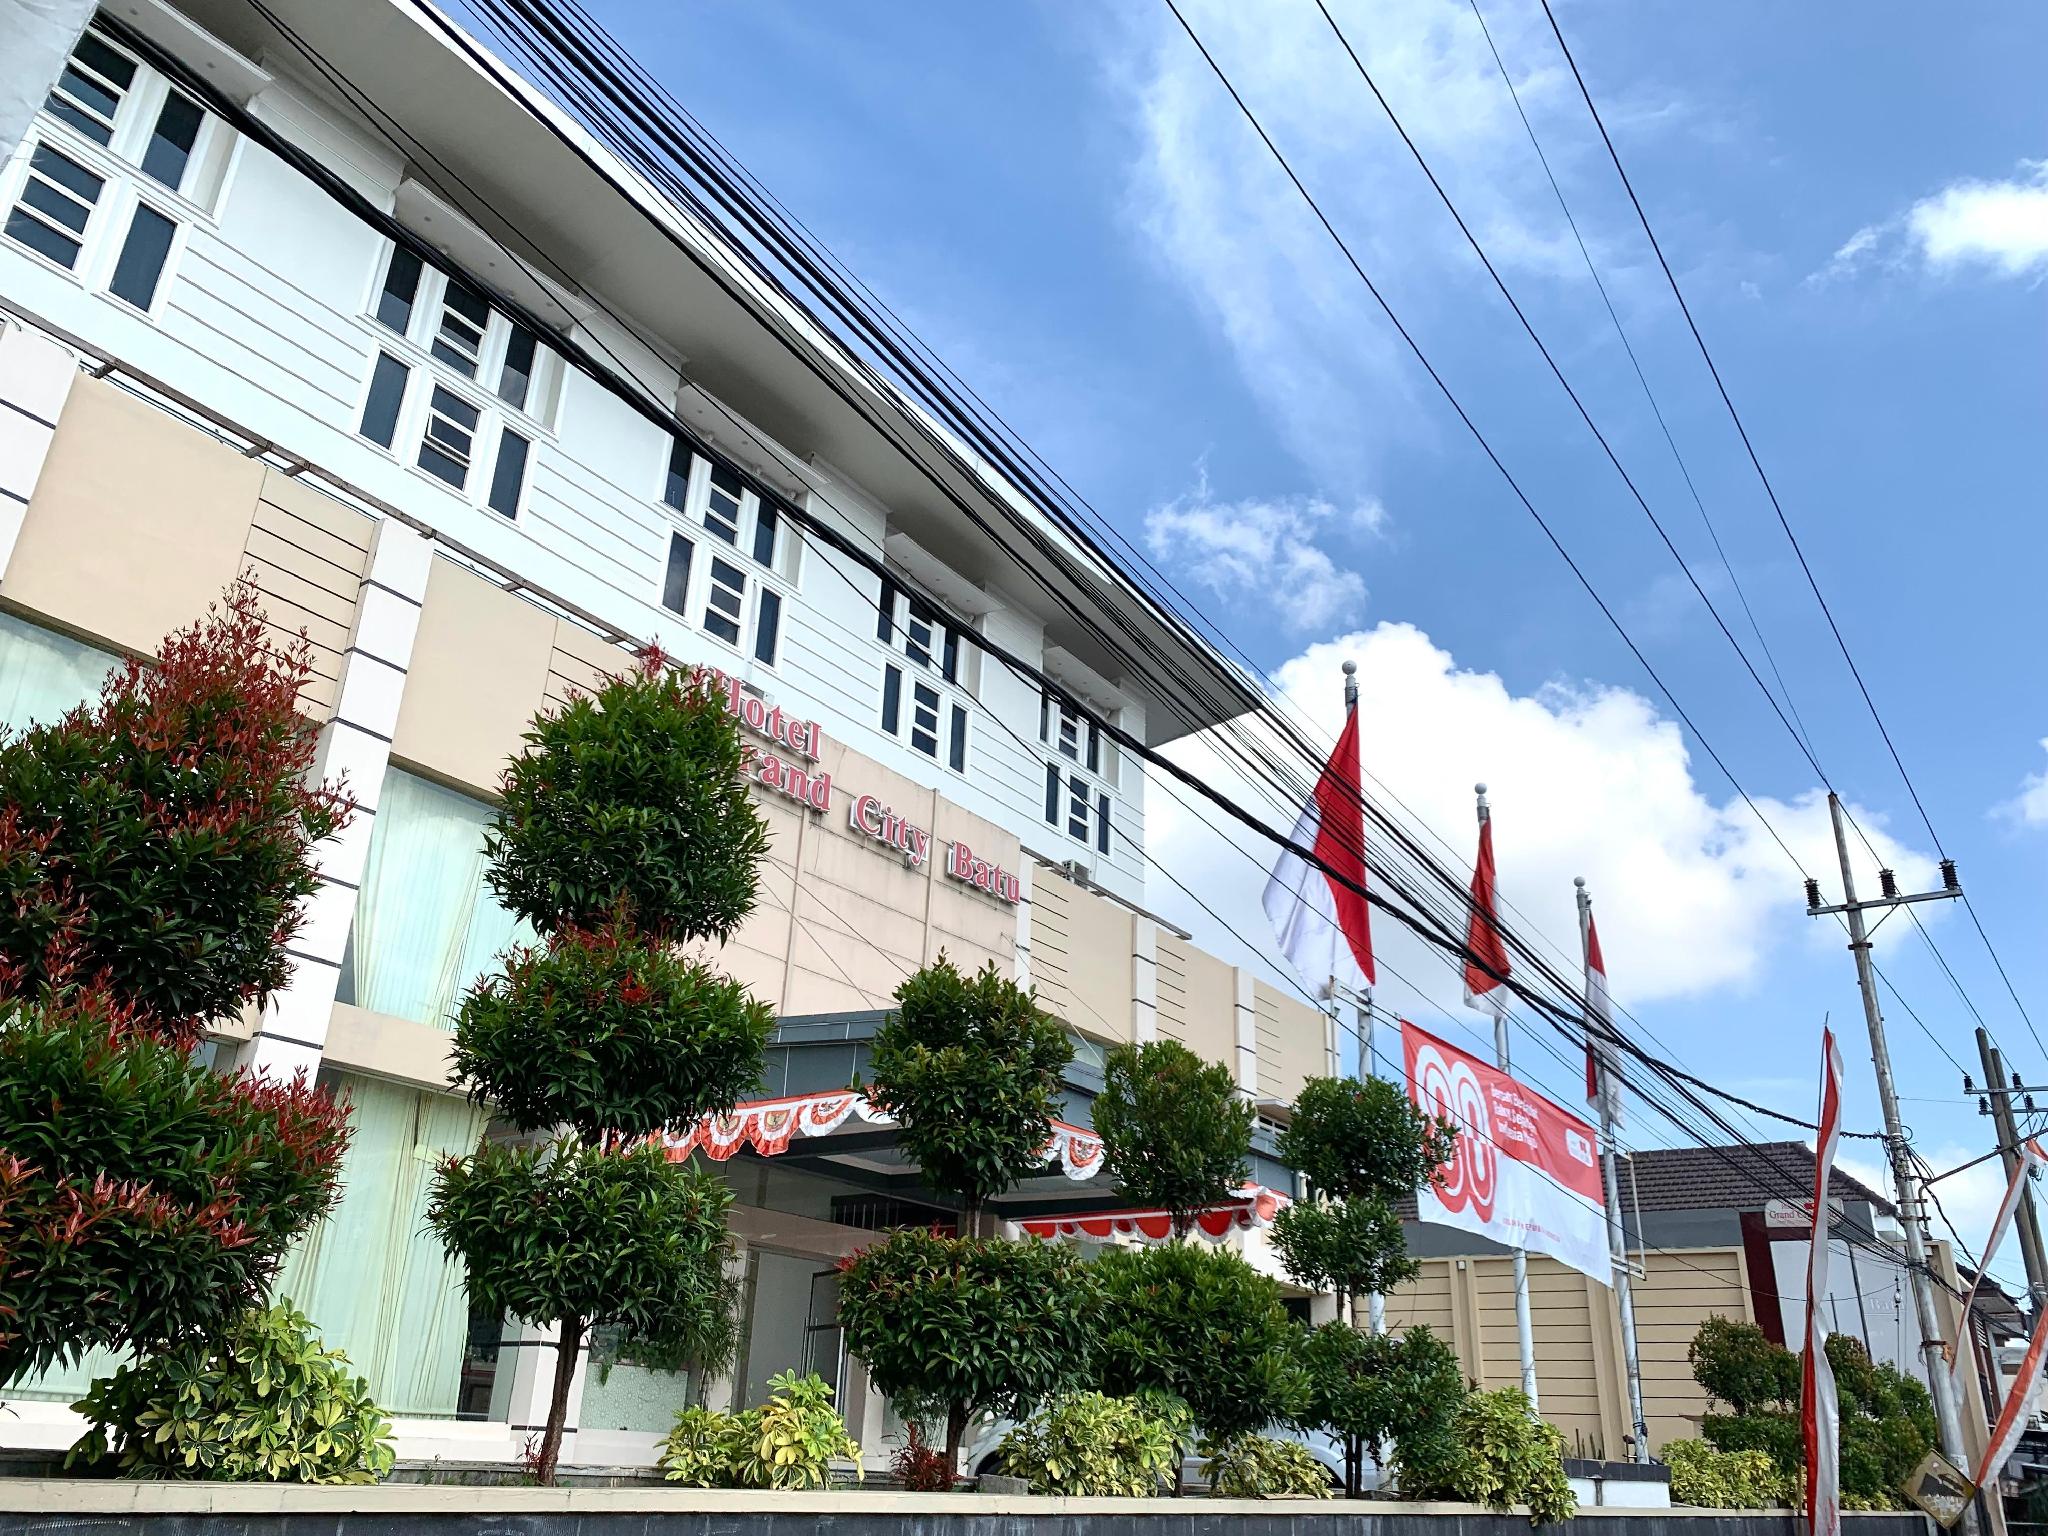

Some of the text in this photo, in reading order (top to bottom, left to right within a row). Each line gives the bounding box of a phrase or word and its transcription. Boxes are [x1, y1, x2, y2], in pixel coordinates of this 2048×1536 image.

[711, 667, 823, 763] Hotel
[738, 744, 1021, 906] rand City Batu
[1769, 1210, 1795, 1219] Grand
